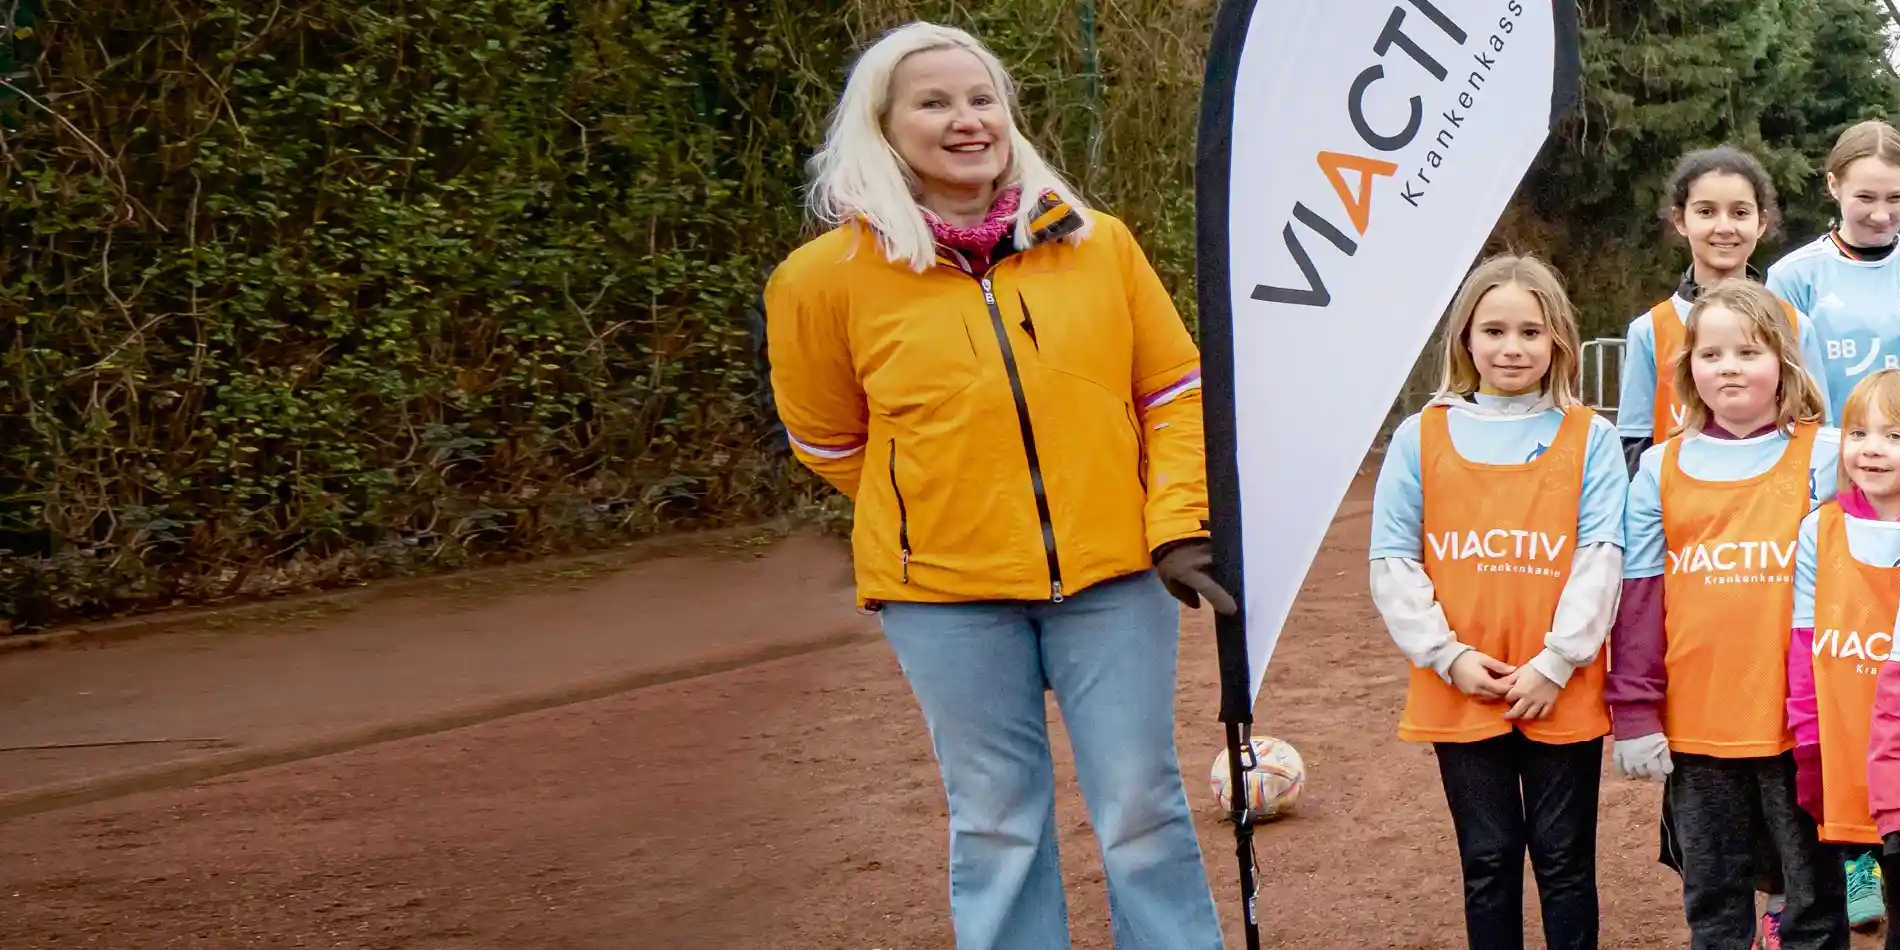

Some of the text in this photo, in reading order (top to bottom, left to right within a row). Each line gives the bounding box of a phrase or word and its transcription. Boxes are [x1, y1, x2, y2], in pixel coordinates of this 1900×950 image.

[1400, 0, 1523, 207] Krankenkass
[1827, 339, 1857, 360] BB
[1426, 528, 1567, 562] VIACTIV
[1668, 540, 1797, 575] VIACTIV
[1476, 562, 1561, 578] Krankenkasse
[1704, 572, 1793, 586] Krankenkass
